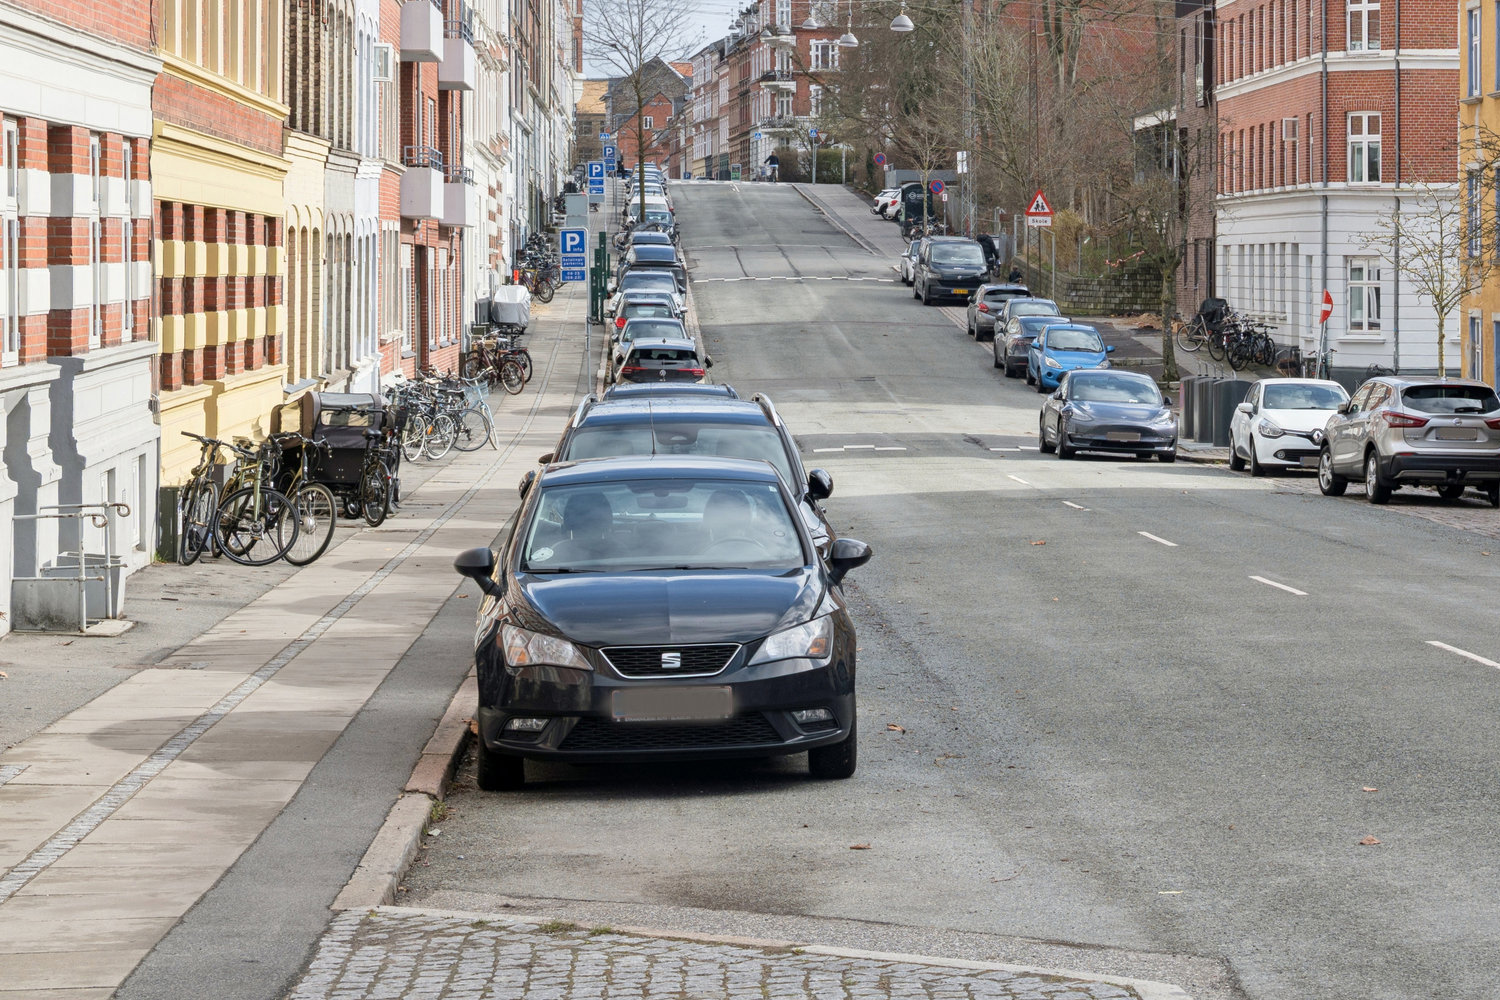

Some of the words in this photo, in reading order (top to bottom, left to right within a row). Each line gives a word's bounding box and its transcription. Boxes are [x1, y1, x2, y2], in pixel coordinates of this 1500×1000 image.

[605, 147, 613, 158] P
[592, 164, 601, 176] P
[566, 232, 580, 252] P
